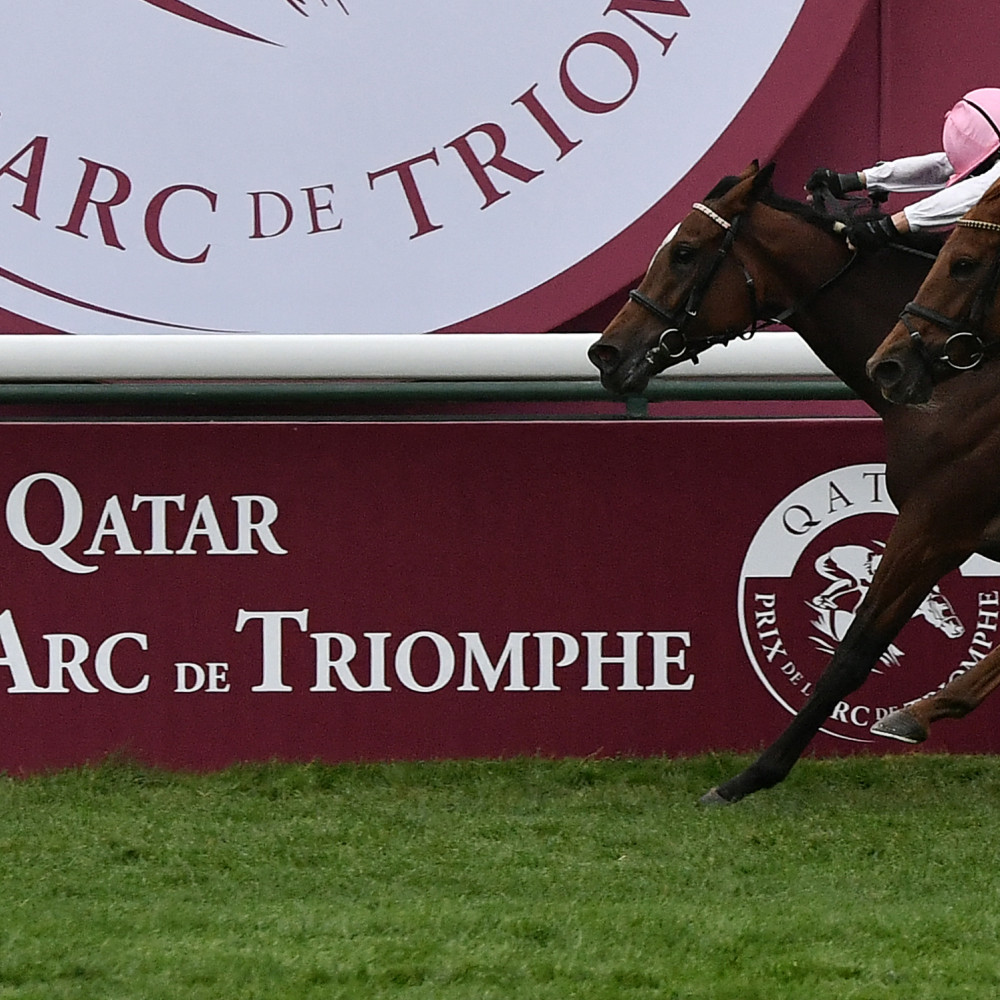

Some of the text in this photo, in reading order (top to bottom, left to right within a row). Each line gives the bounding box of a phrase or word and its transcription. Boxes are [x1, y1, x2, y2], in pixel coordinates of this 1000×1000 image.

[247, 184, 342, 238] DE
[6, 473, 287, 573] QATAR
[783, 472, 887, 536] QAT
[175, 663, 230, 692] DE
[236, 609, 694, 692] TRIOMPHE
[755, 593, 787, 663] PRIX
[781, 661, 804, 685] DE
